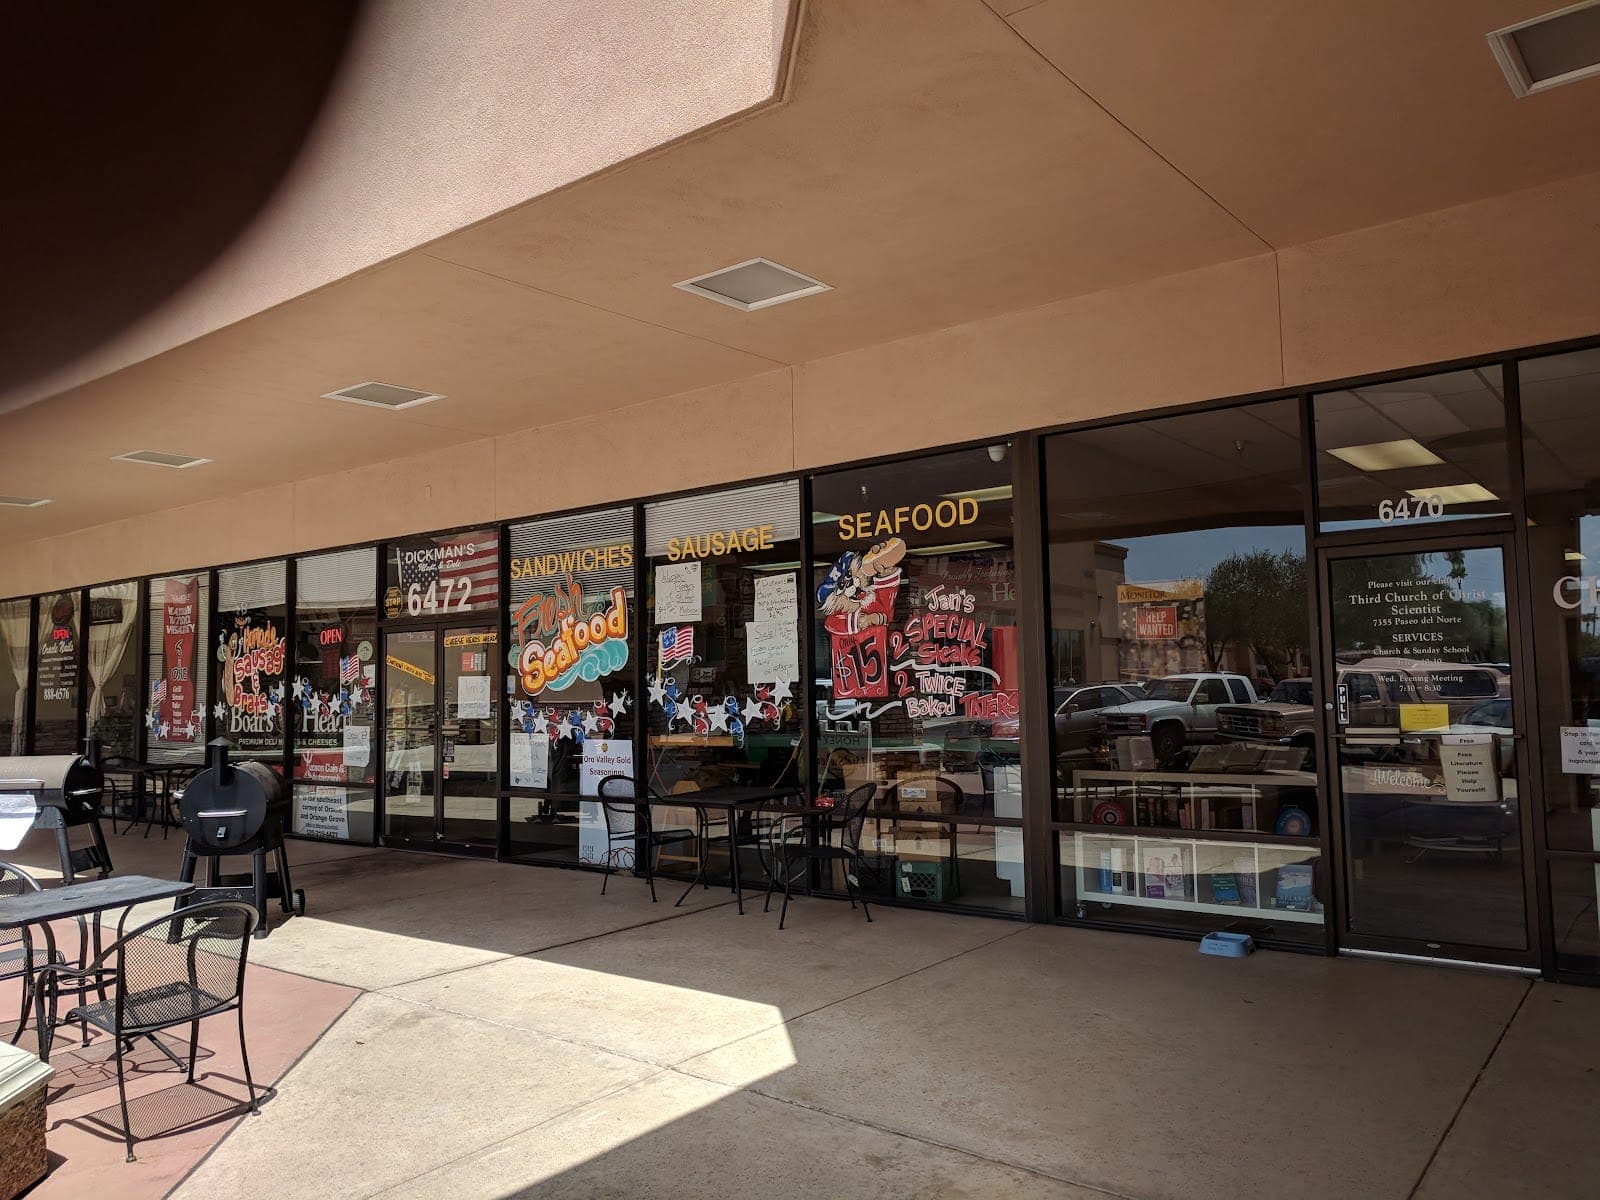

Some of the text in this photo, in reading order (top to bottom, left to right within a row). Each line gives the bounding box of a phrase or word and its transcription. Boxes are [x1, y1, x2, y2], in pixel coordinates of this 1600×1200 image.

[838, 498, 979, 540] SEAFOOD
[1378, 495, 1444, 523] 6470
[405, 543, 476, 564] DICKMAN'S
[668, 525, 774, 562] SAUSAGE
[510, 544, 634, 579] SANDWICHES
[1368, 580, 1393, 588] Please
[408, 576, 472, 616] 6472
[1348, 592, 1381, 604] Third
[1384, 591, 1428, 603] Church
[1432, 590, 1444, 600] of
[512, 573, 586, 646] Fresh
[1145, 611, 1167, 623] HELP
[1391, 604, 1442, 616] Scientist
[1139, 624, 1174, 636] WANTED
[1373, 619, 1392, 627] 7355
[1394, 617, 1418, 626] Paseo
[1421, 616, 1434, 624] del
[320, 628, 342, 645] OPEN
[518, 586, 628, 696] Seafood
[890, 612, 988, 660] 2 SPECIAL
[1392, 632, 1444, 643] SERVICES
[918, 642, 982, 666] Steaks
[1412, 647, 1440, 656] Sunday
[1443, 646, 1470, 654] School
[836, 636, 882, 692] $15
[895, 671, 966, 697] 2 TWICE
[1399, 675, 1429, 683] Evening
[1431, 674, 1464, 683] Meeting
[905, 691, 1019, 719] Baked TATERS
[230, 707, 274, 732] Boars
[596, 756, 615, 766] Valley
[1374, 768, 1431, 788] Welcome
